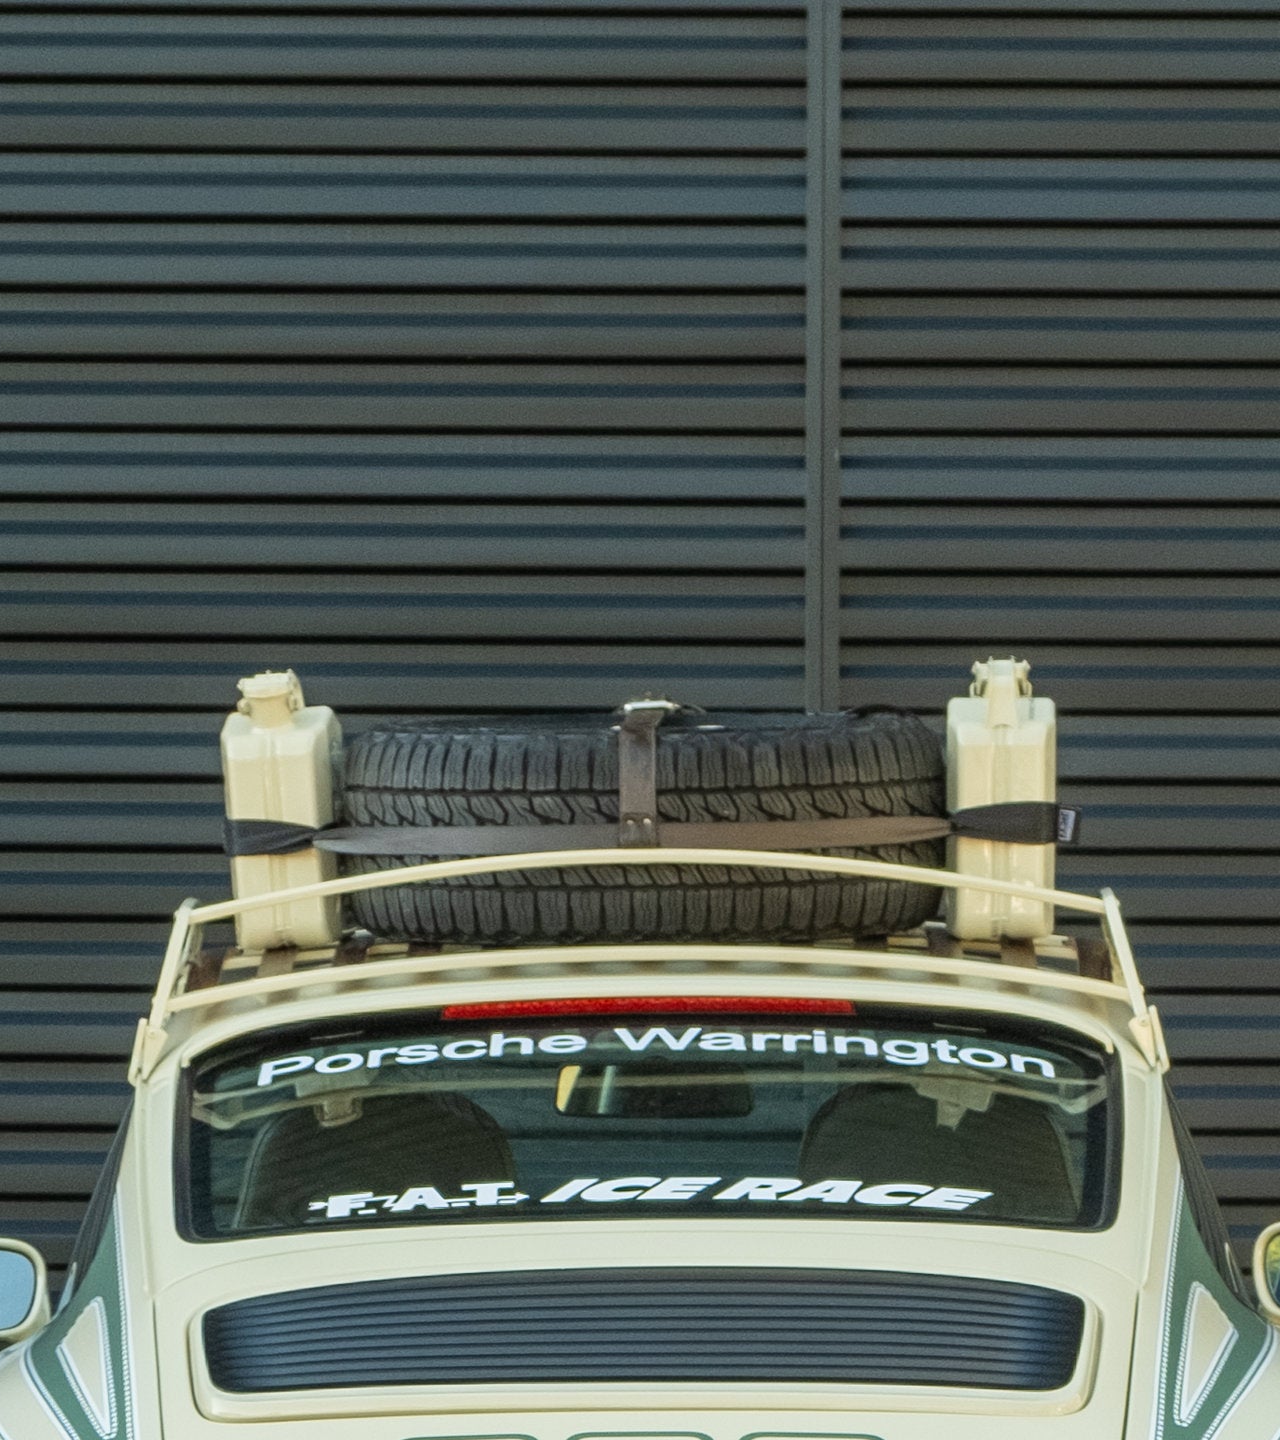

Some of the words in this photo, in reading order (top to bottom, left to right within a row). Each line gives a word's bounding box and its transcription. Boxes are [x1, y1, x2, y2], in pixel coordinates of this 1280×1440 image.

[257, 1033, 587, 1086] Porsche
[614, 1027, 1056, 1078] Warrington
[540, 1177, 721, 1203] ICE
[712, 1177, 994, 1211] RACE
